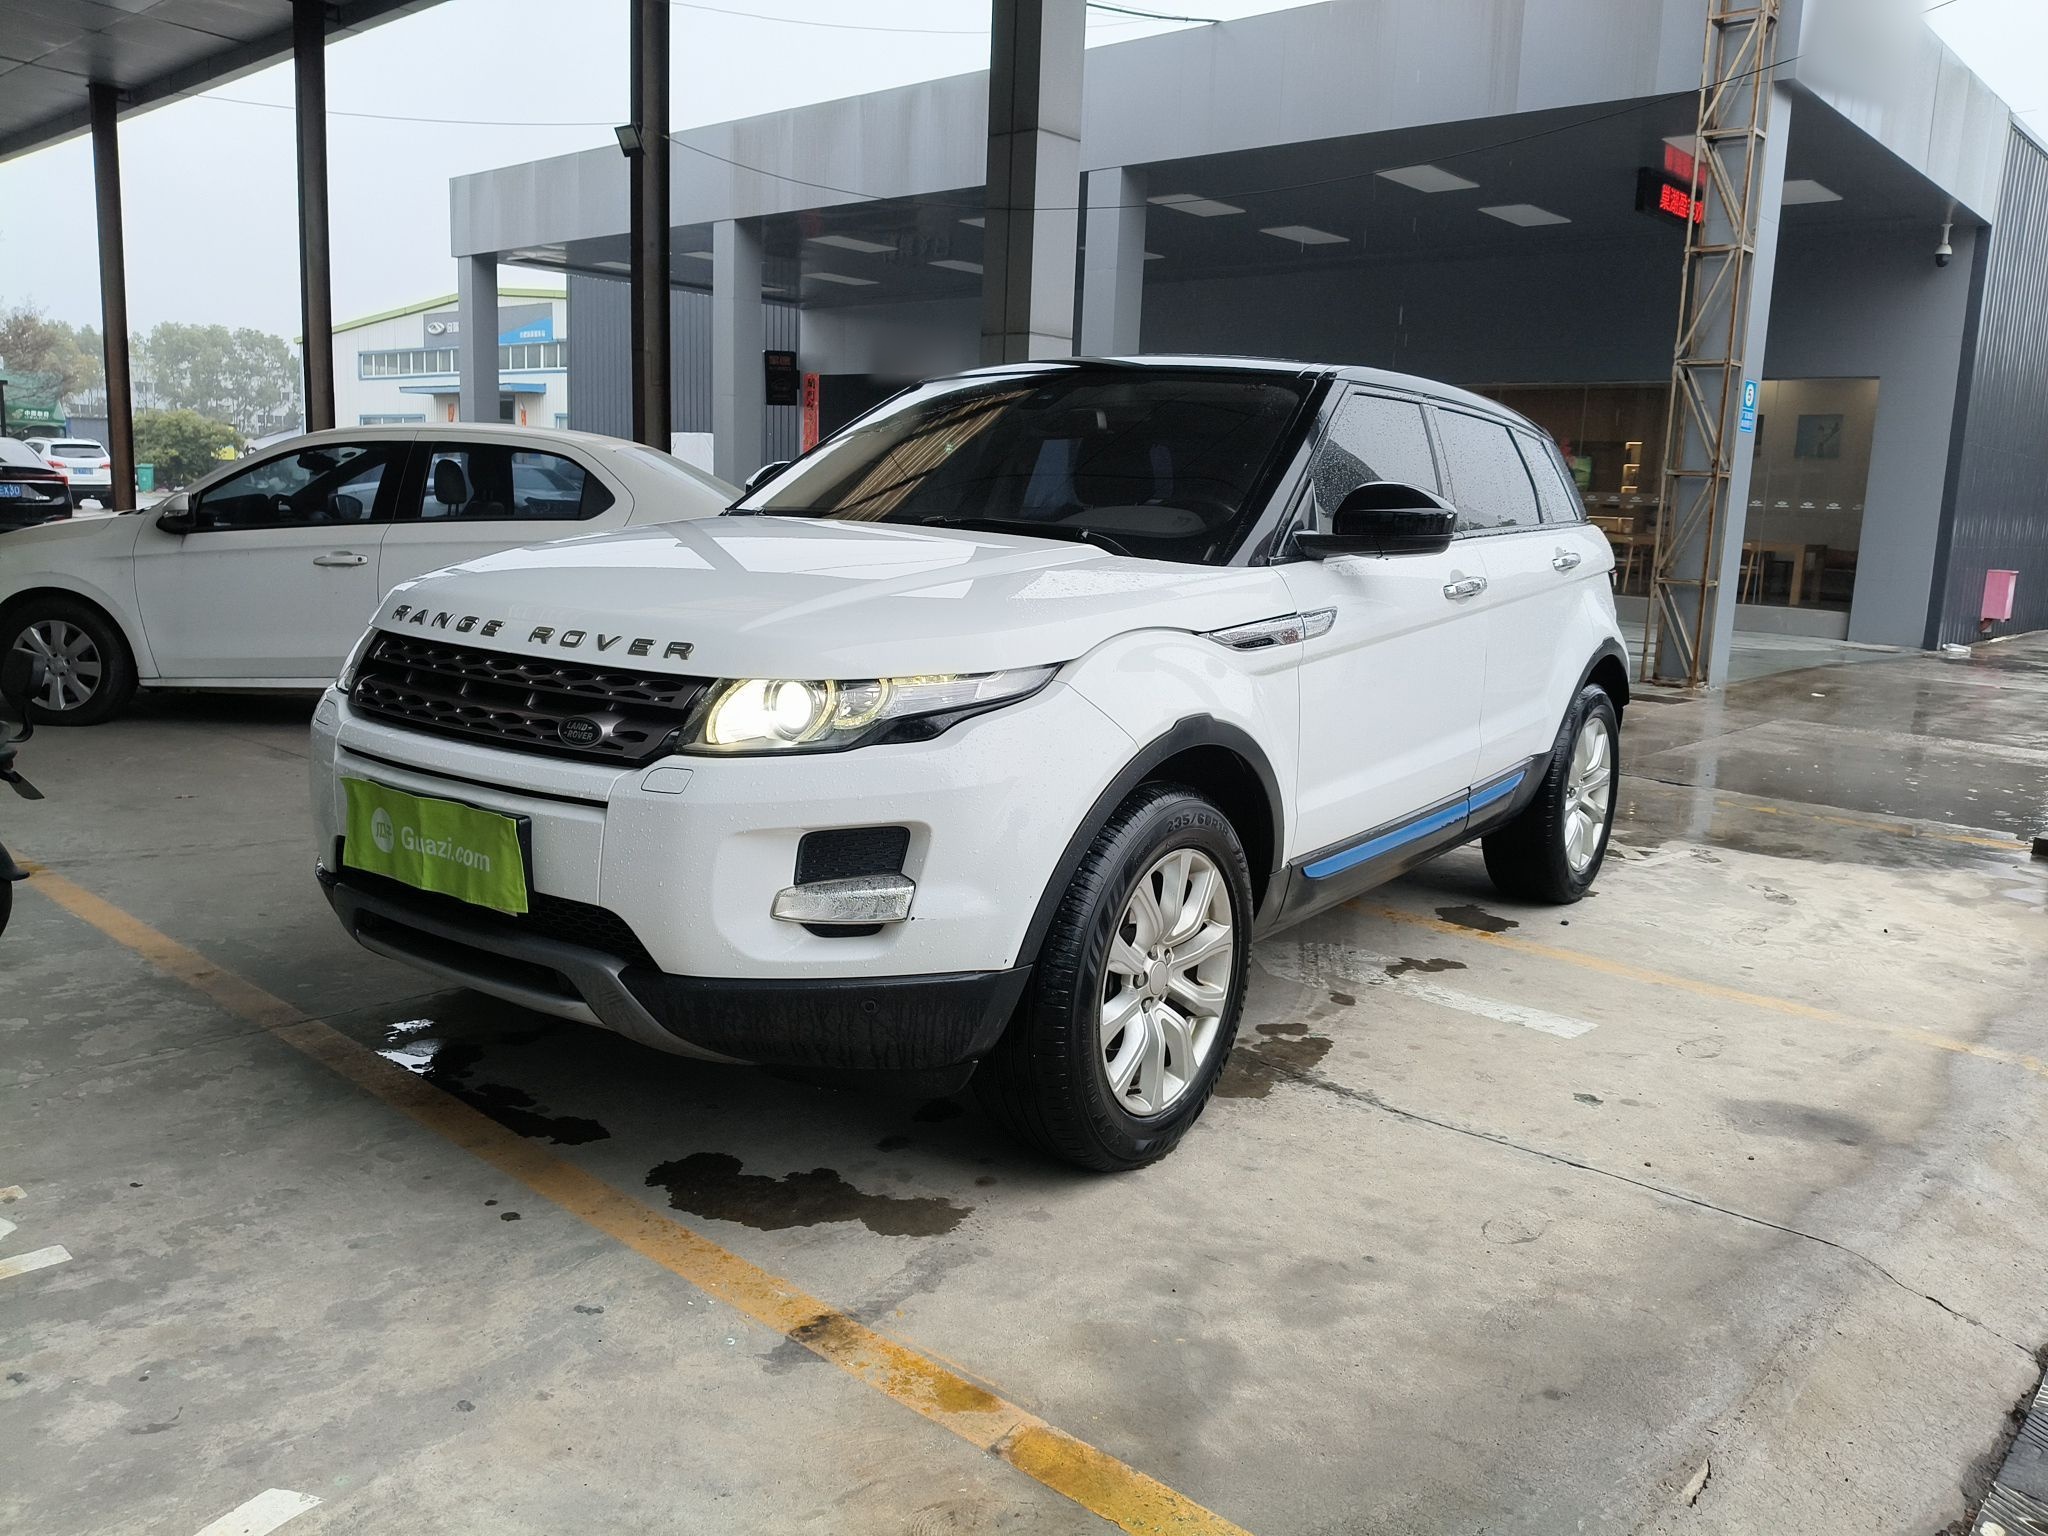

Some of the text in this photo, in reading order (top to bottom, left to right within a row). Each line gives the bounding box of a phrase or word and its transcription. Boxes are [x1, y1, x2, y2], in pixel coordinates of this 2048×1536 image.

[392, 604, 695, 661] RANGE ROVER
[401, 826, 490, 872] Guazi.com
